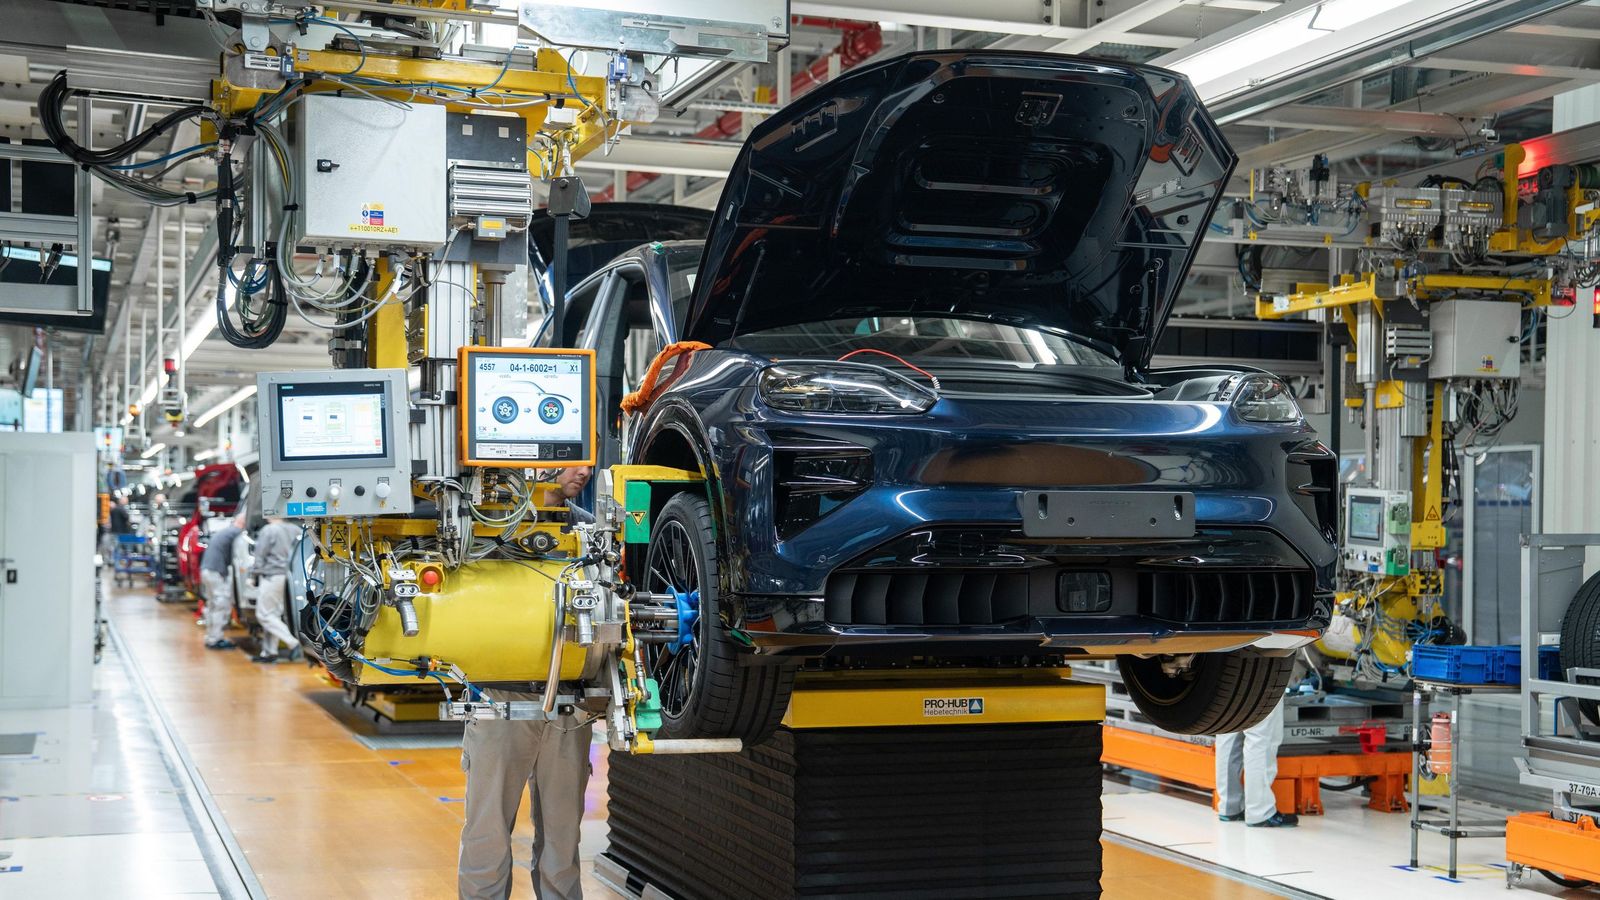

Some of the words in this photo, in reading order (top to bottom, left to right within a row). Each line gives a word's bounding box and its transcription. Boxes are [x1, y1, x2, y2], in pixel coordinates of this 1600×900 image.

[479, 363, 496, 371] 4557
[509, 363, 557, 373] 04-1-6002=1
[569, 364, 578, 372] X1
[924, 699, 967, 708] PRO-HUB
[1291, 727, 1325, 736] LFD-NR:
[1569, 783, 1597, 796] 37-70A
